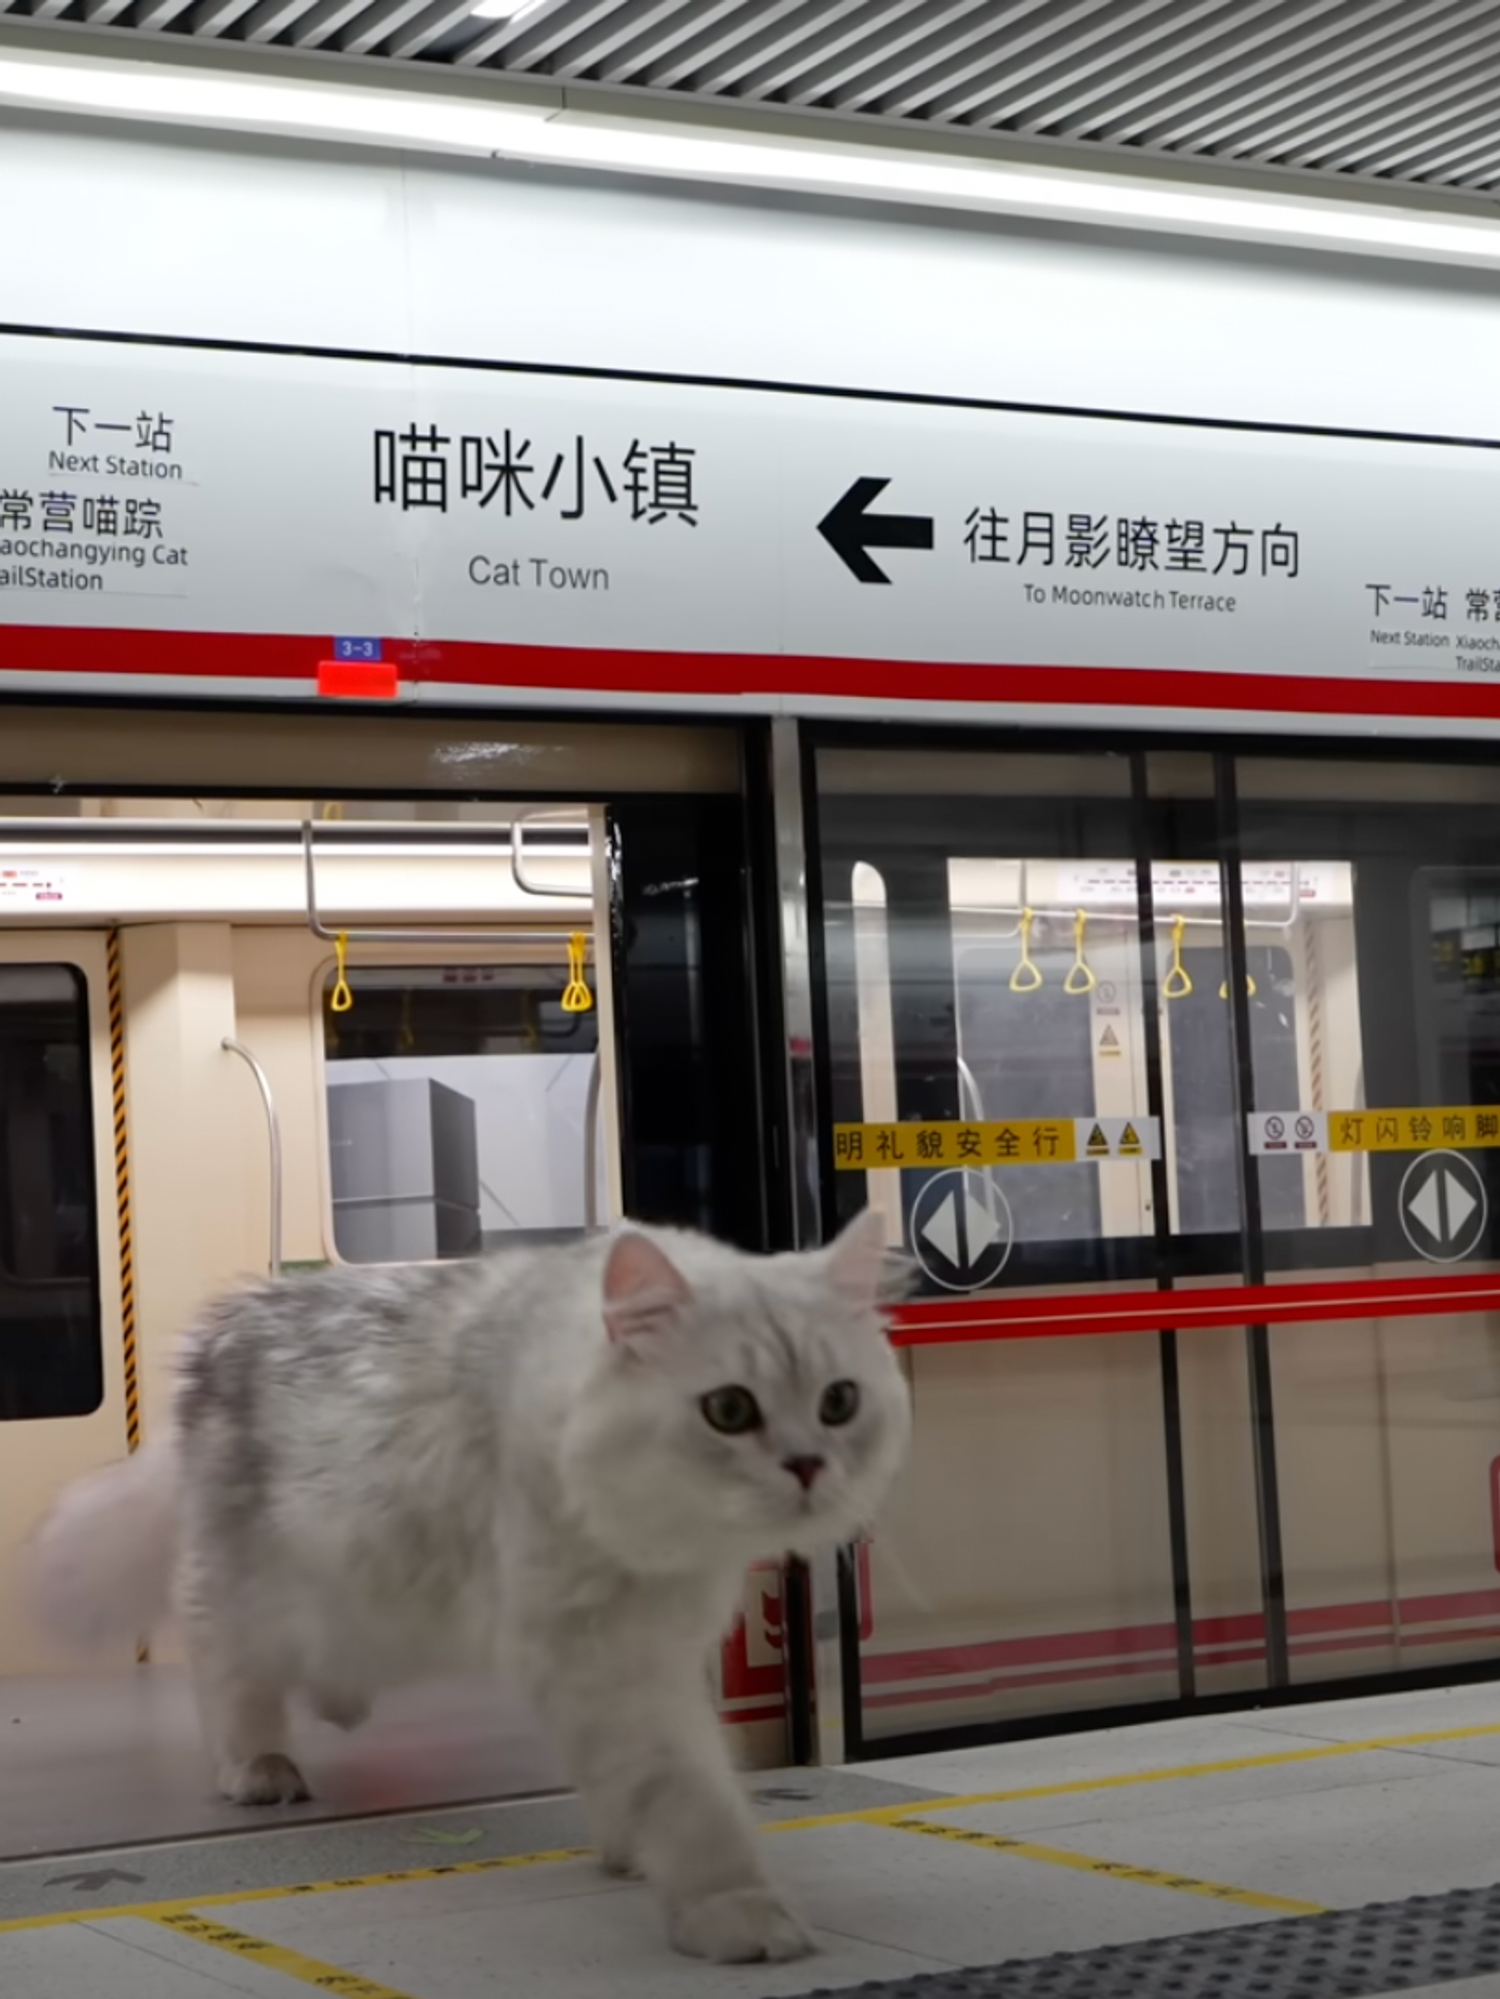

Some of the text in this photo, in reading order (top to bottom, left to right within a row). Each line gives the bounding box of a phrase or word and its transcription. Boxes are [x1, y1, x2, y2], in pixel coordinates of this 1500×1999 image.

[53, 406, 174, 453] 下一站
[49, 450, 182, 480] Next Station
[374, 422, 698, 527] 喵咪小镇
[0, 488, 163, 539] 常营喵踪
[153, 544, 188, 566] Cat
[964, 506, 1299, 578] 往月影瞭望方向
[468, 555, 610, 590] Cat Town
[1024, 584, 1236, 612] To Moonwatch Terrace
[1365, 584, 1500, 622] 下一站 常
[342, 641, 373, 657] 3-3
[1370, 629, 1401, 645] Next
[1404, 631, 1450, 648] Station
[836, 1126, 1060, 1161] 明礼貌安全行
[1341, 1114, 1499, 1145] 灯闪铃响脚
